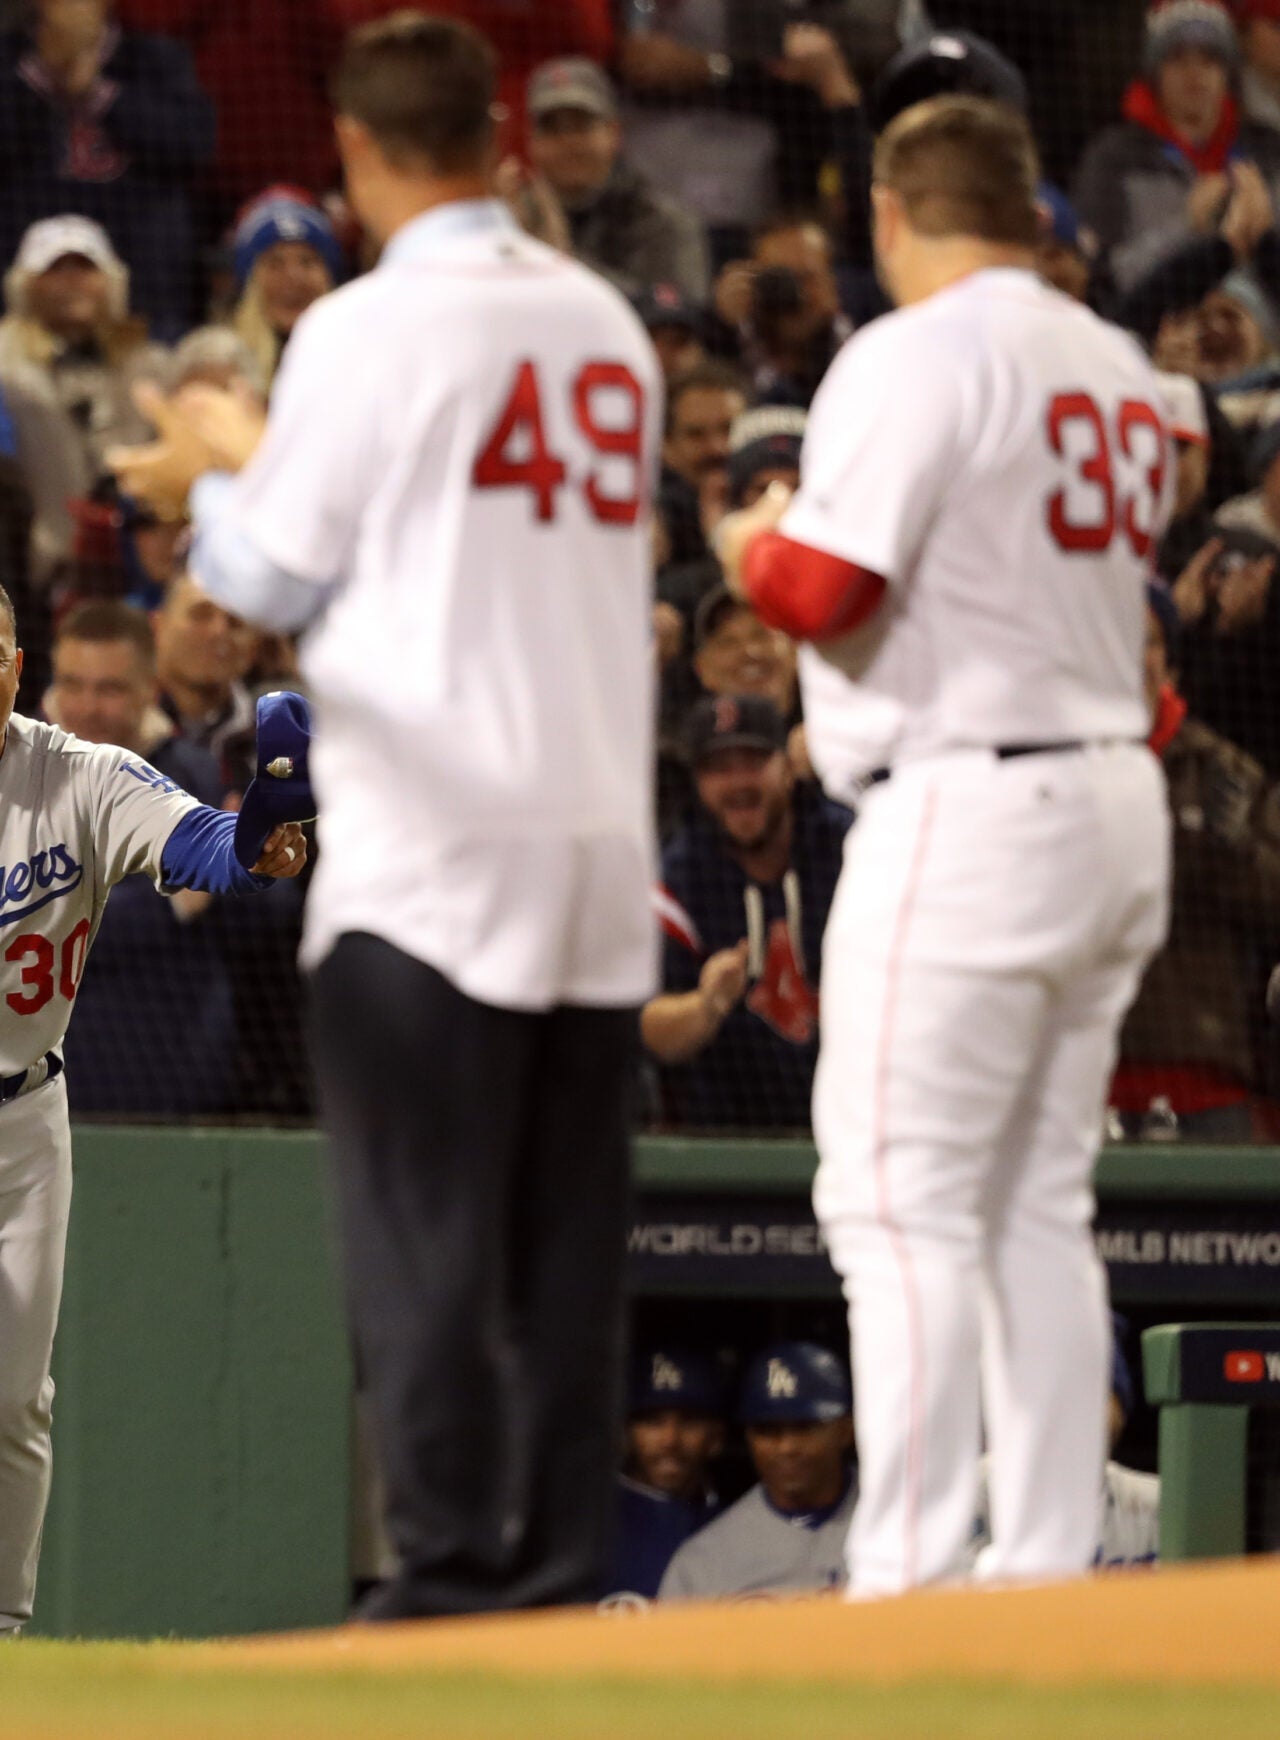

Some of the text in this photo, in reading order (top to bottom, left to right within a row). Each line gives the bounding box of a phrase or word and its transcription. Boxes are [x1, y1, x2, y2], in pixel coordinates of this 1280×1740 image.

[472, 361, 642, 527] 49
[5, 918, 91, 1016] 30
[627, 1224, 762, 1255] WORLD
